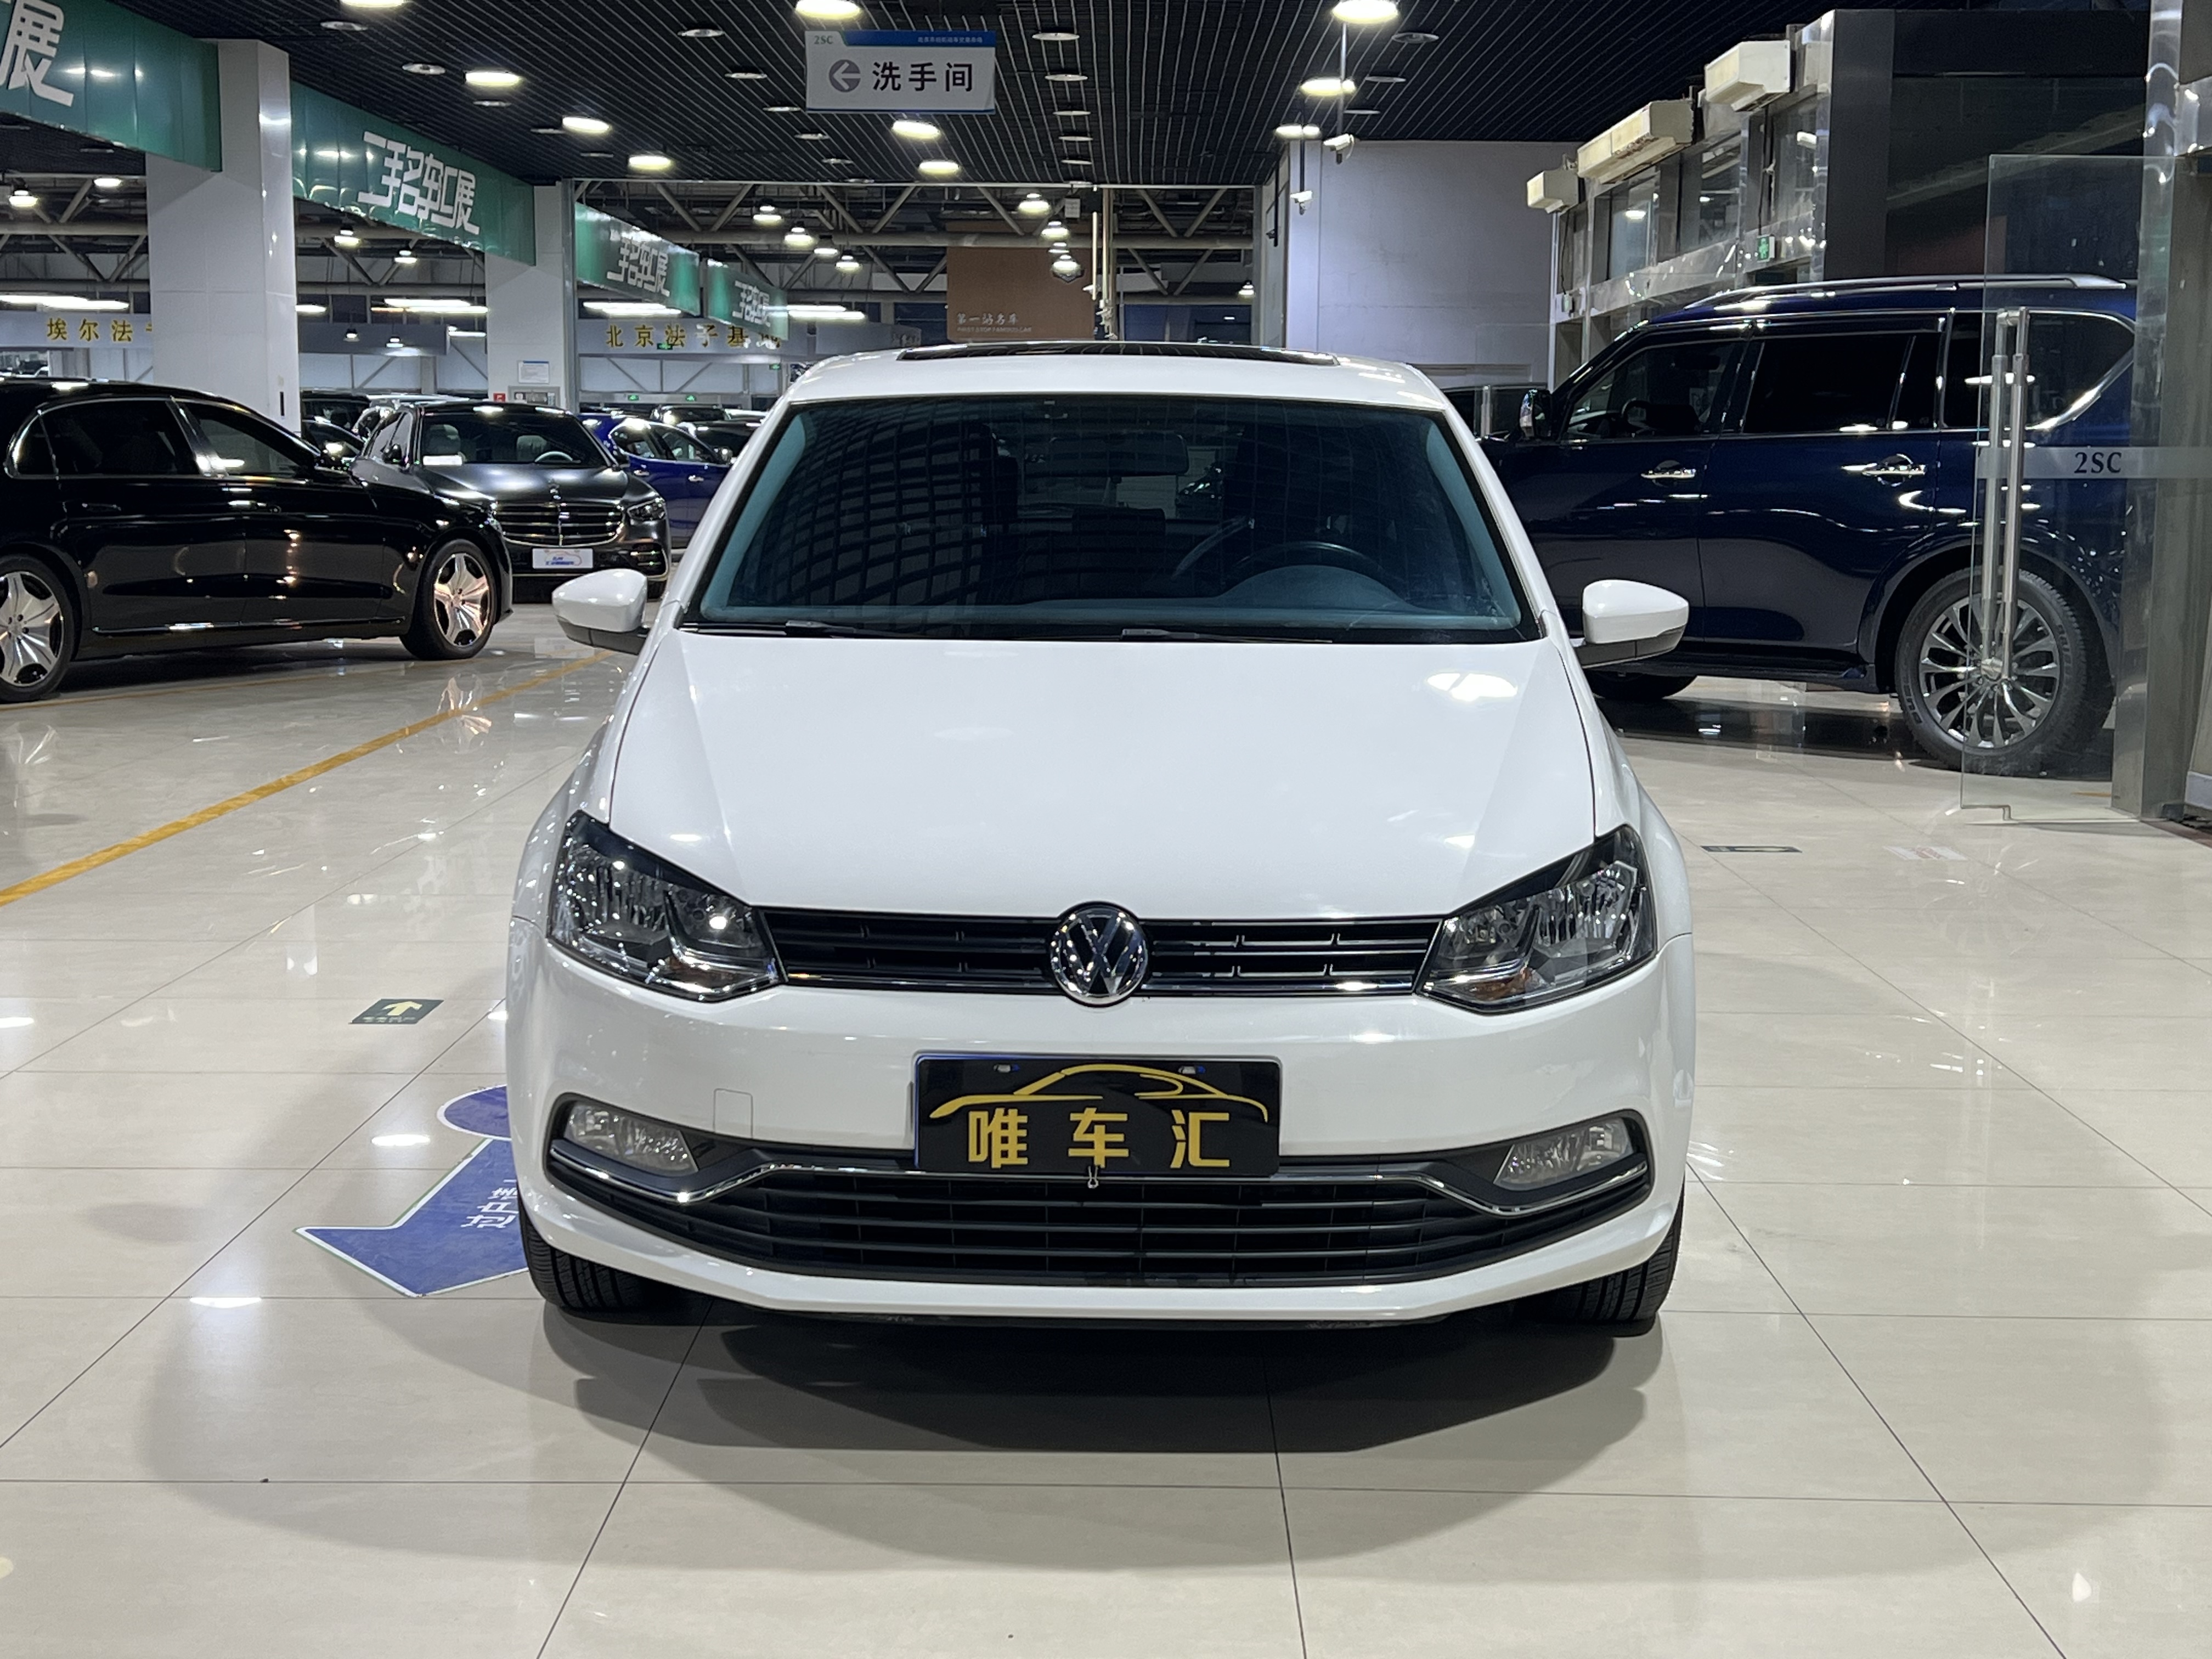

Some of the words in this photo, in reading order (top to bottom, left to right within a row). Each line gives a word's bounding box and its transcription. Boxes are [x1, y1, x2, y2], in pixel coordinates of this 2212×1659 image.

[814, 35, 834, 44] 2SC
[872, 61, 973, 92] 洗手间
[2074, 452, 2122, 474] 2SC
[968, 1107, 1230, 1169] 唯车汇
[460, 1179, 520, 1228] 过户请
